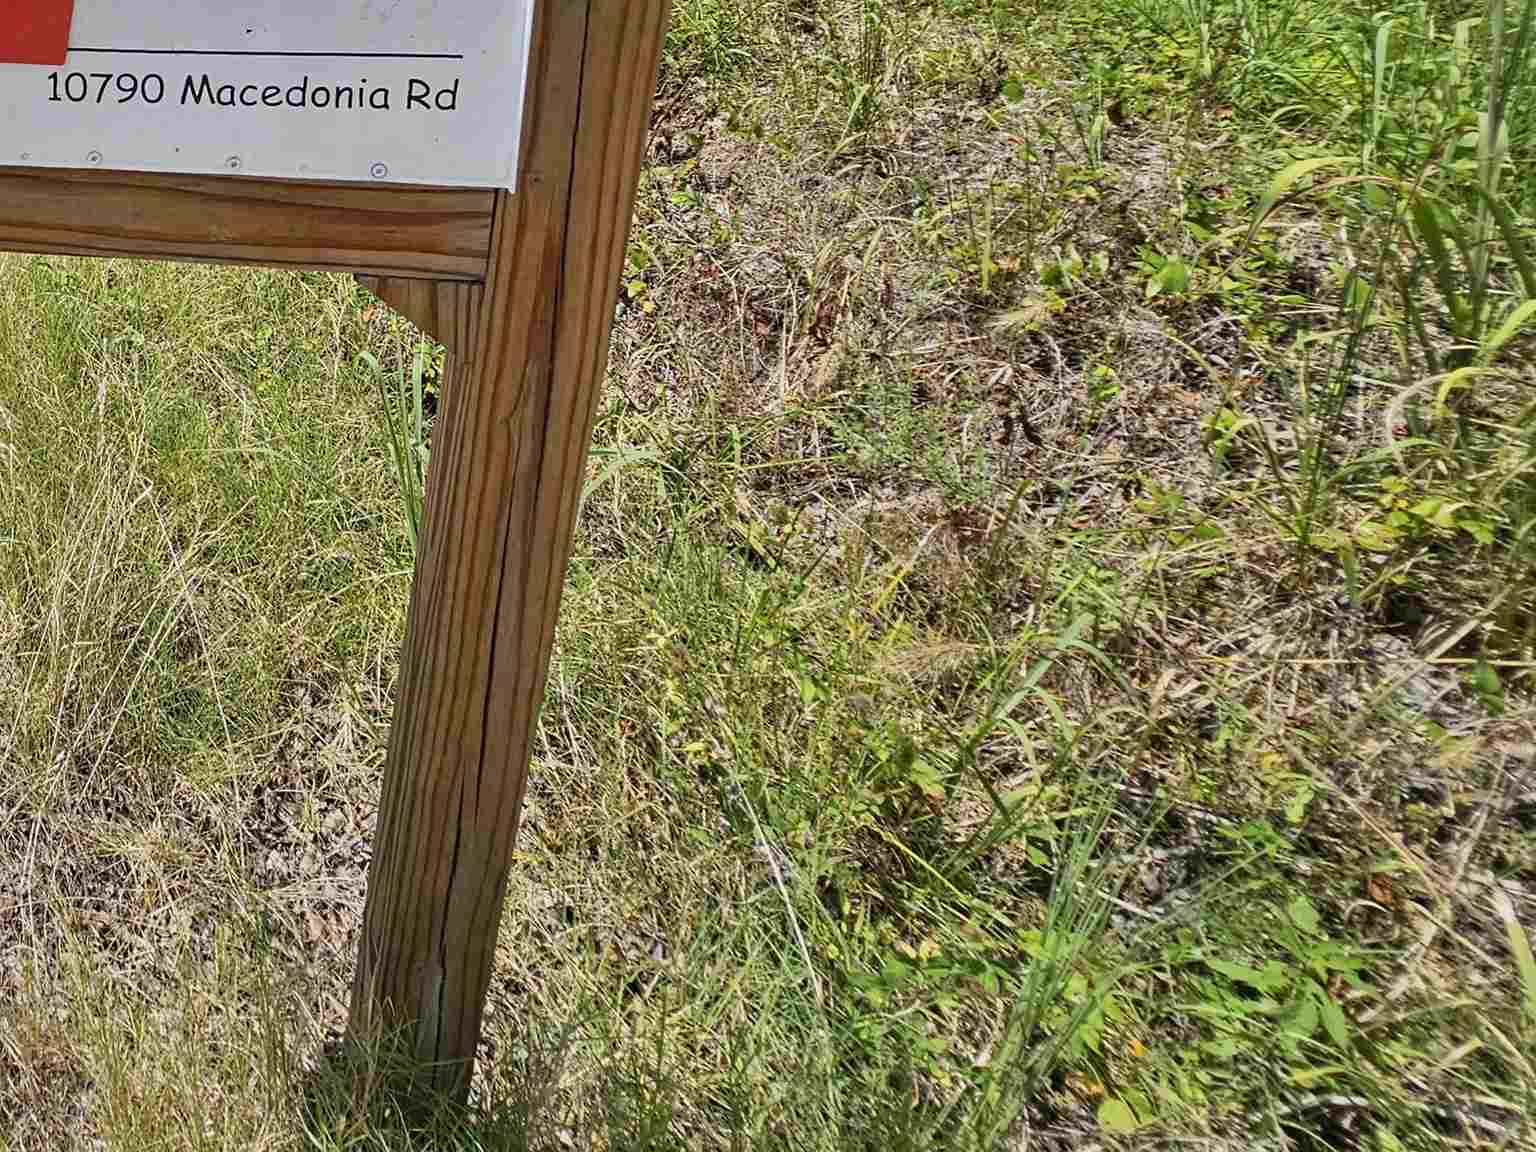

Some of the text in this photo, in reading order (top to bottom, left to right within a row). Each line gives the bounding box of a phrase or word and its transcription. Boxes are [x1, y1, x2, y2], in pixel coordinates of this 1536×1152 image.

[47, 71, 460, 111] 10790 Macedonia Rd
